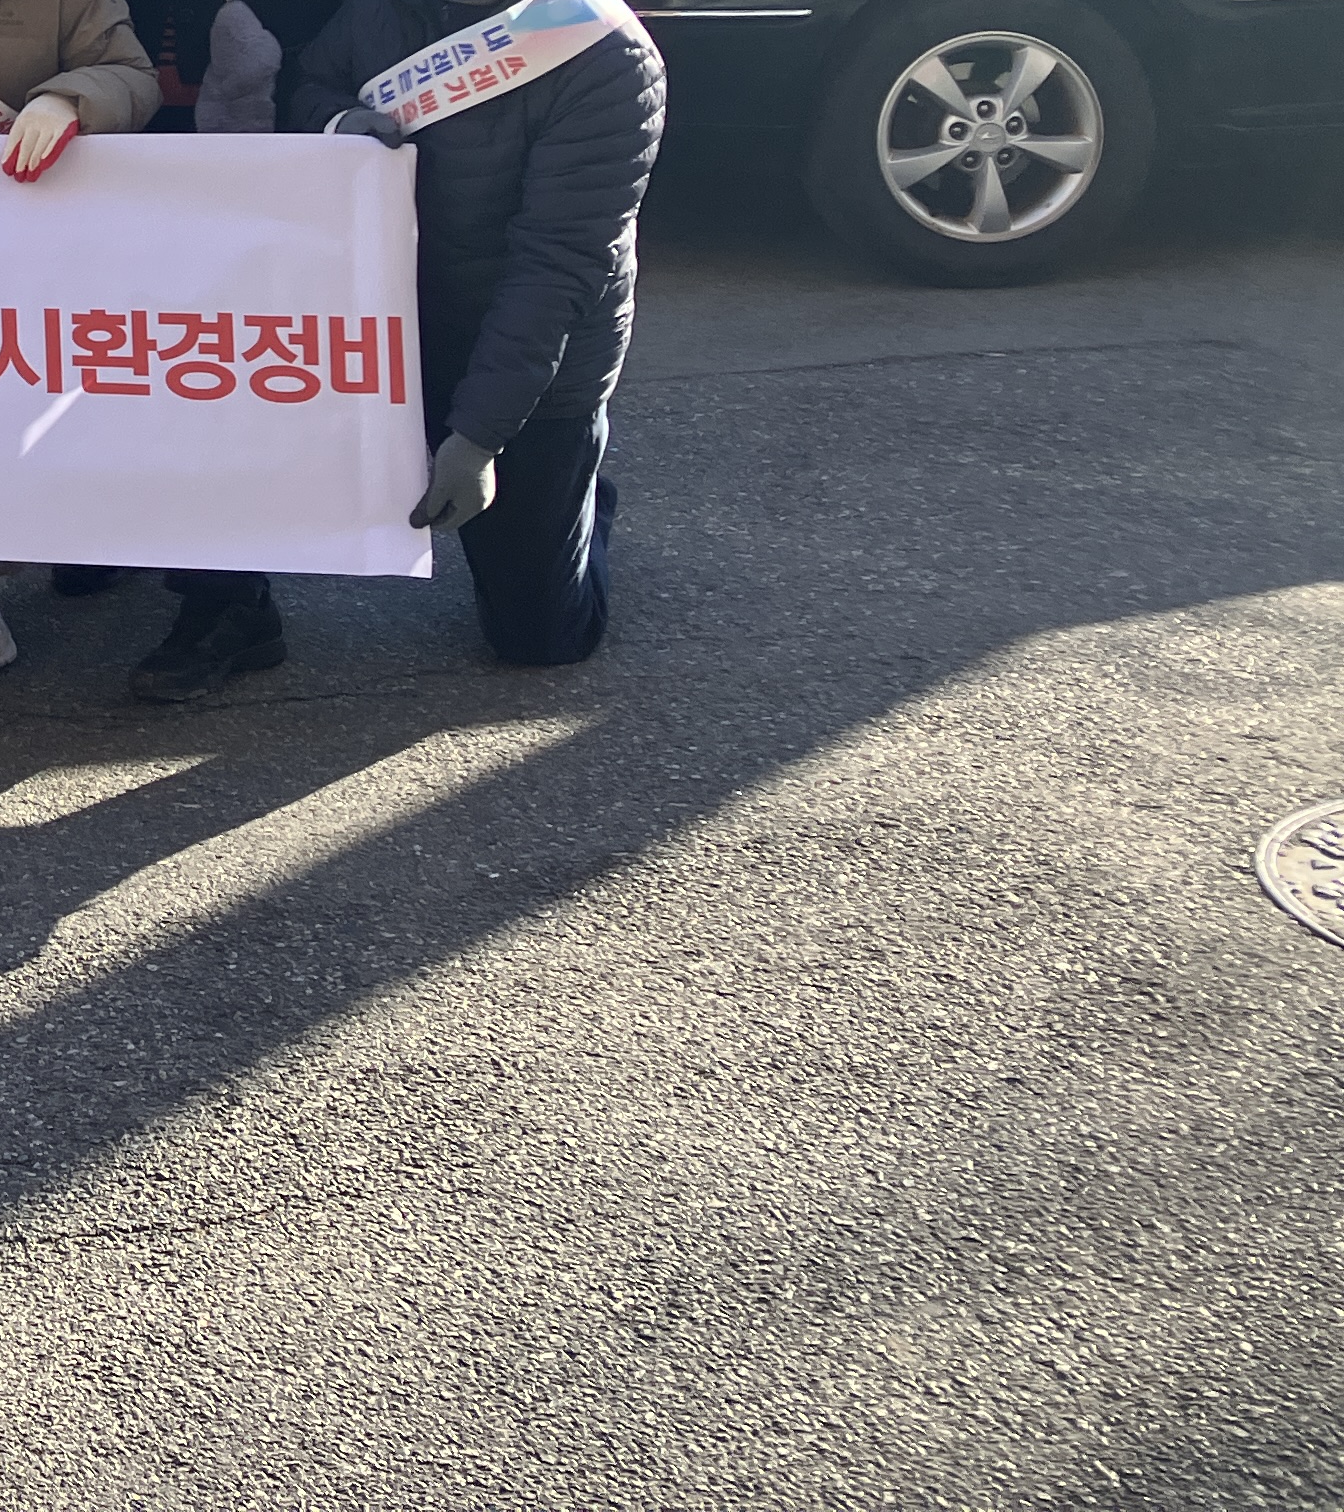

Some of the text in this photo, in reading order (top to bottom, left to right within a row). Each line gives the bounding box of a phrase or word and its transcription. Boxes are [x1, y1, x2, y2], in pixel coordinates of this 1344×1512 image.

[379, 24, 514, 105] 내 쓰레기는 내
[443, 55, 528, 104] 쓰레기
